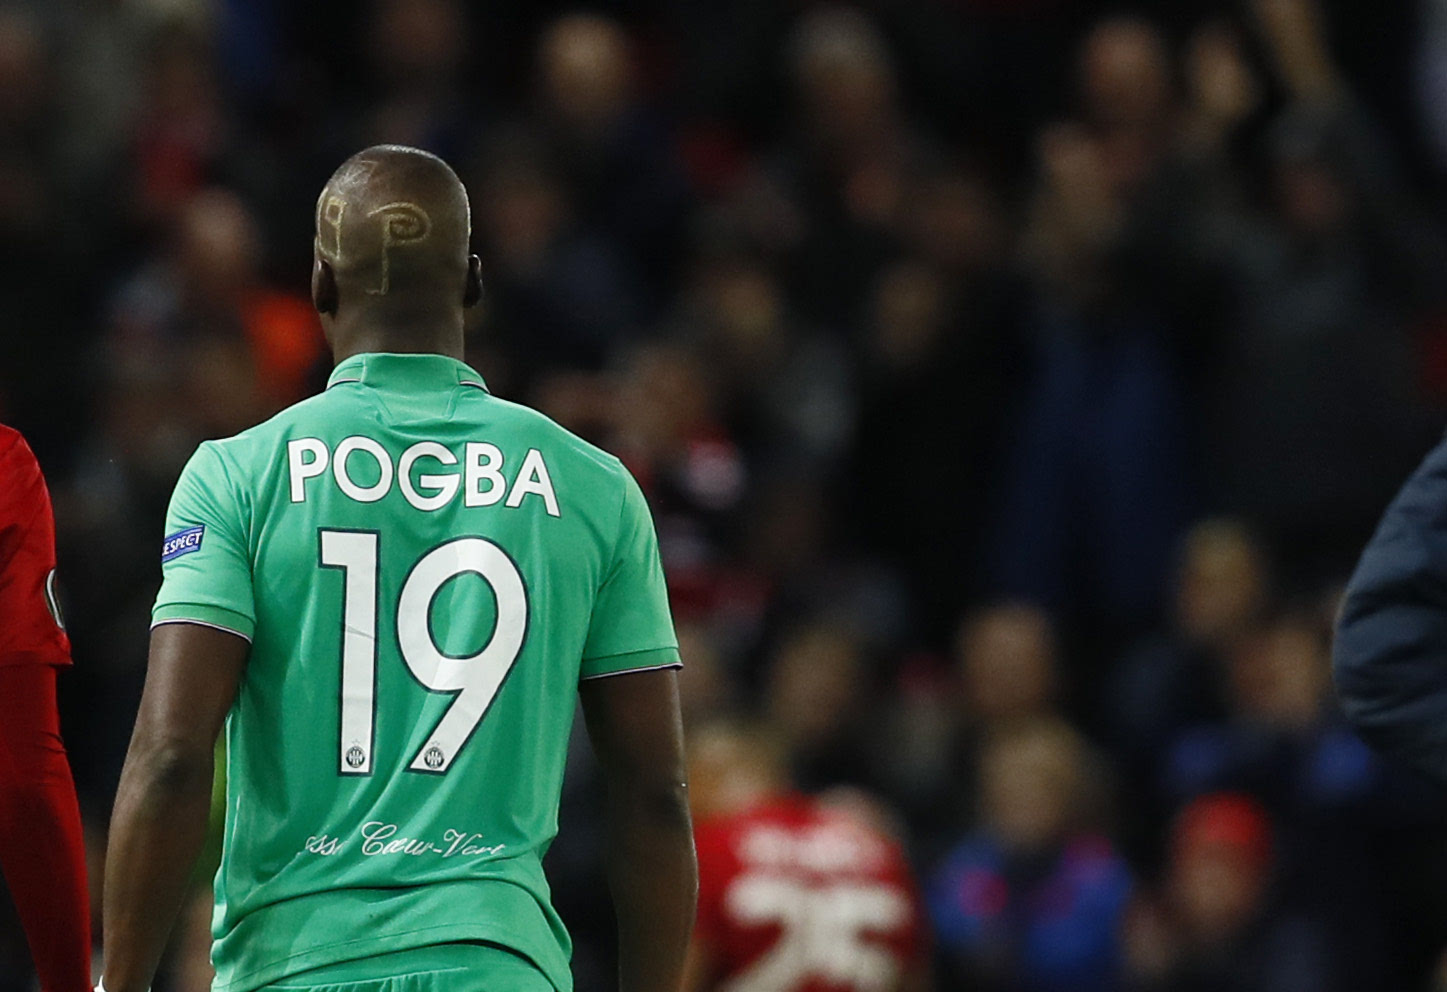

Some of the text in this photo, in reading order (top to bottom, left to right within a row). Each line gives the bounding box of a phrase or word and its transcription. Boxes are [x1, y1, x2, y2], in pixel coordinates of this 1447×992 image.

[287, 435, 561, 518] POGBA
[162, 531, 203, 557] ESPECT
[317, 527, 531, 777] 19
